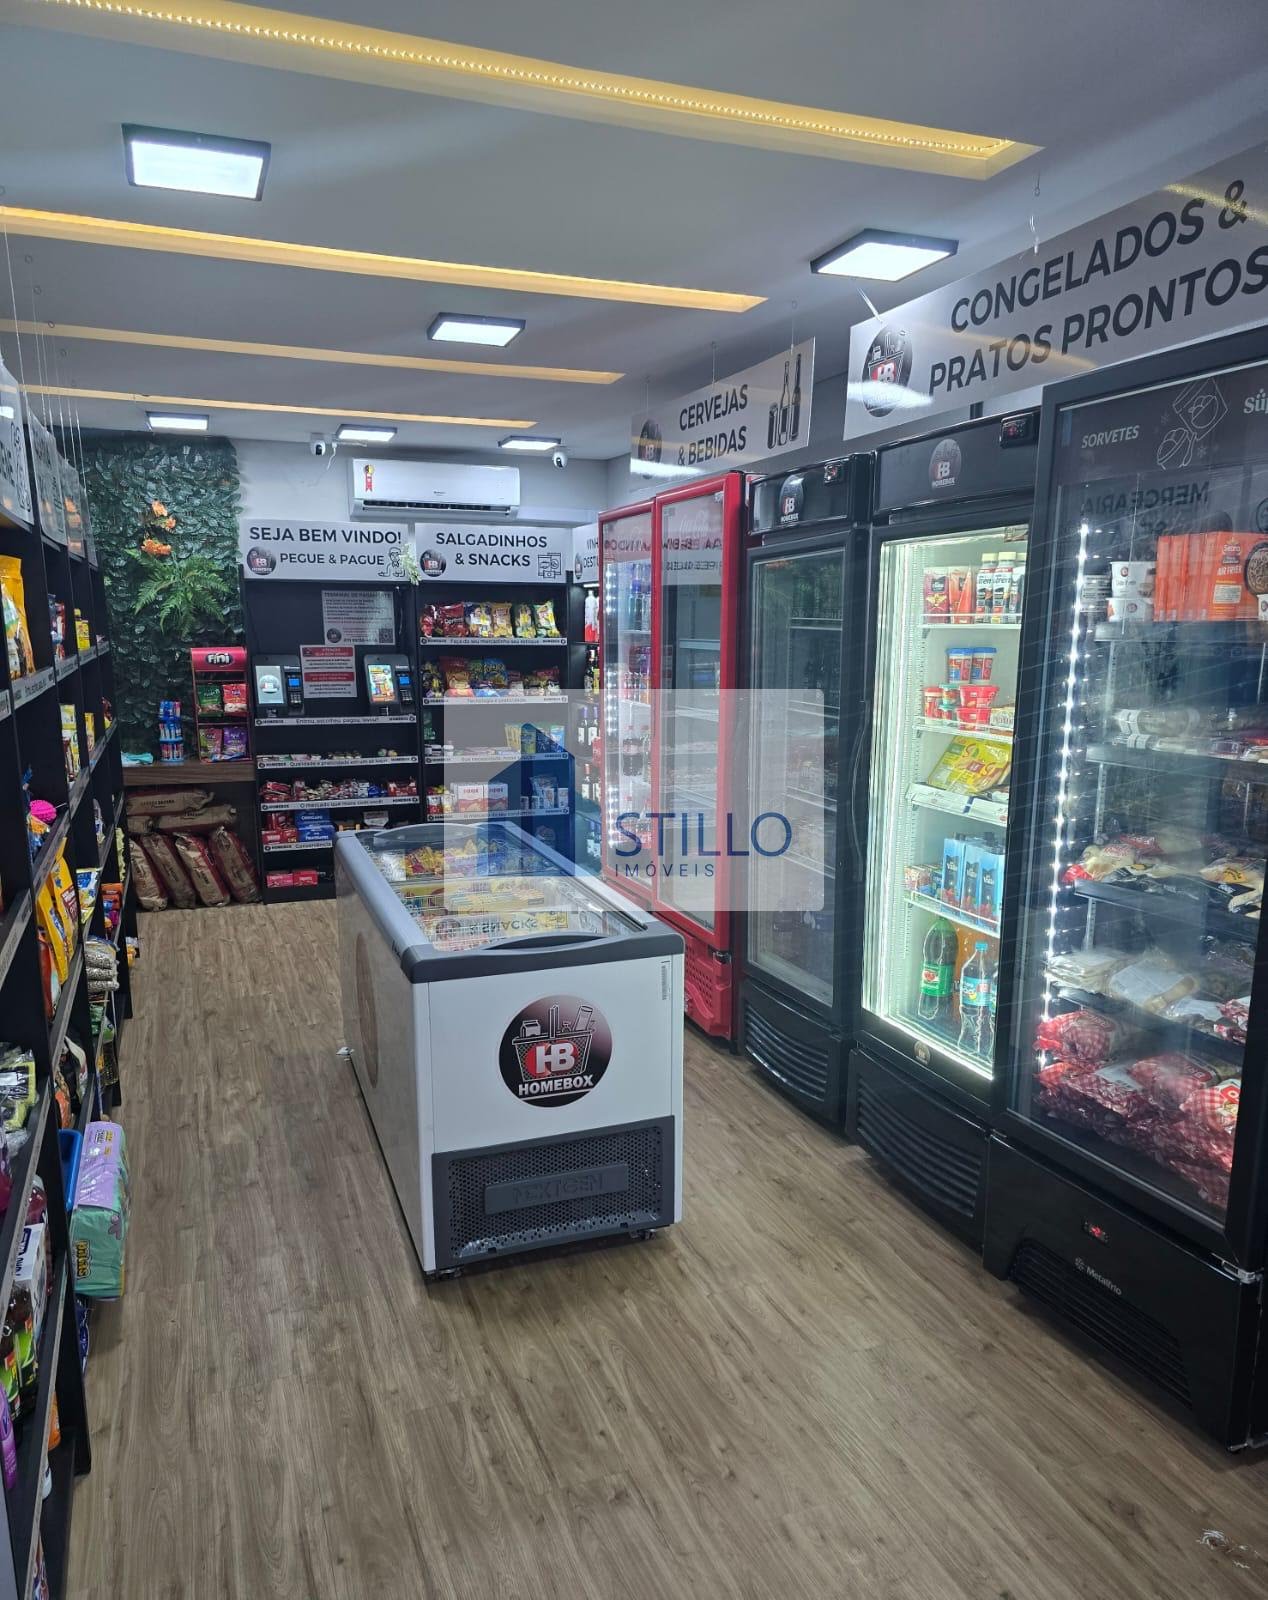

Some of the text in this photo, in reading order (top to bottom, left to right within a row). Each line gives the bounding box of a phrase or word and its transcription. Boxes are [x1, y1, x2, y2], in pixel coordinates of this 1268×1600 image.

[951, 179, 1248, 333] CONGELADOS &
[929, 243, 1268, 396] PRATOS PRONTOS
[679, 383, 748, 431] CERVEJAS
[678, 425, 747, 466] & BEBIDAS
[1082, 424, 1140, 449] SORVETES
[249, 526, 402, 544] SEJA BEM VINDO!
[436, 532, 548, 548] SALGADINHOS
[280, 553, 385, 565] PEGUE & PAGUE
[455, 552, 531, 567] & SNACKS
[535, 1042, 575, 1074] HB
[518, 1074, 595, 1096] HOMEBOX
[1086, 1265, 1122, 1296] Metalfrio
